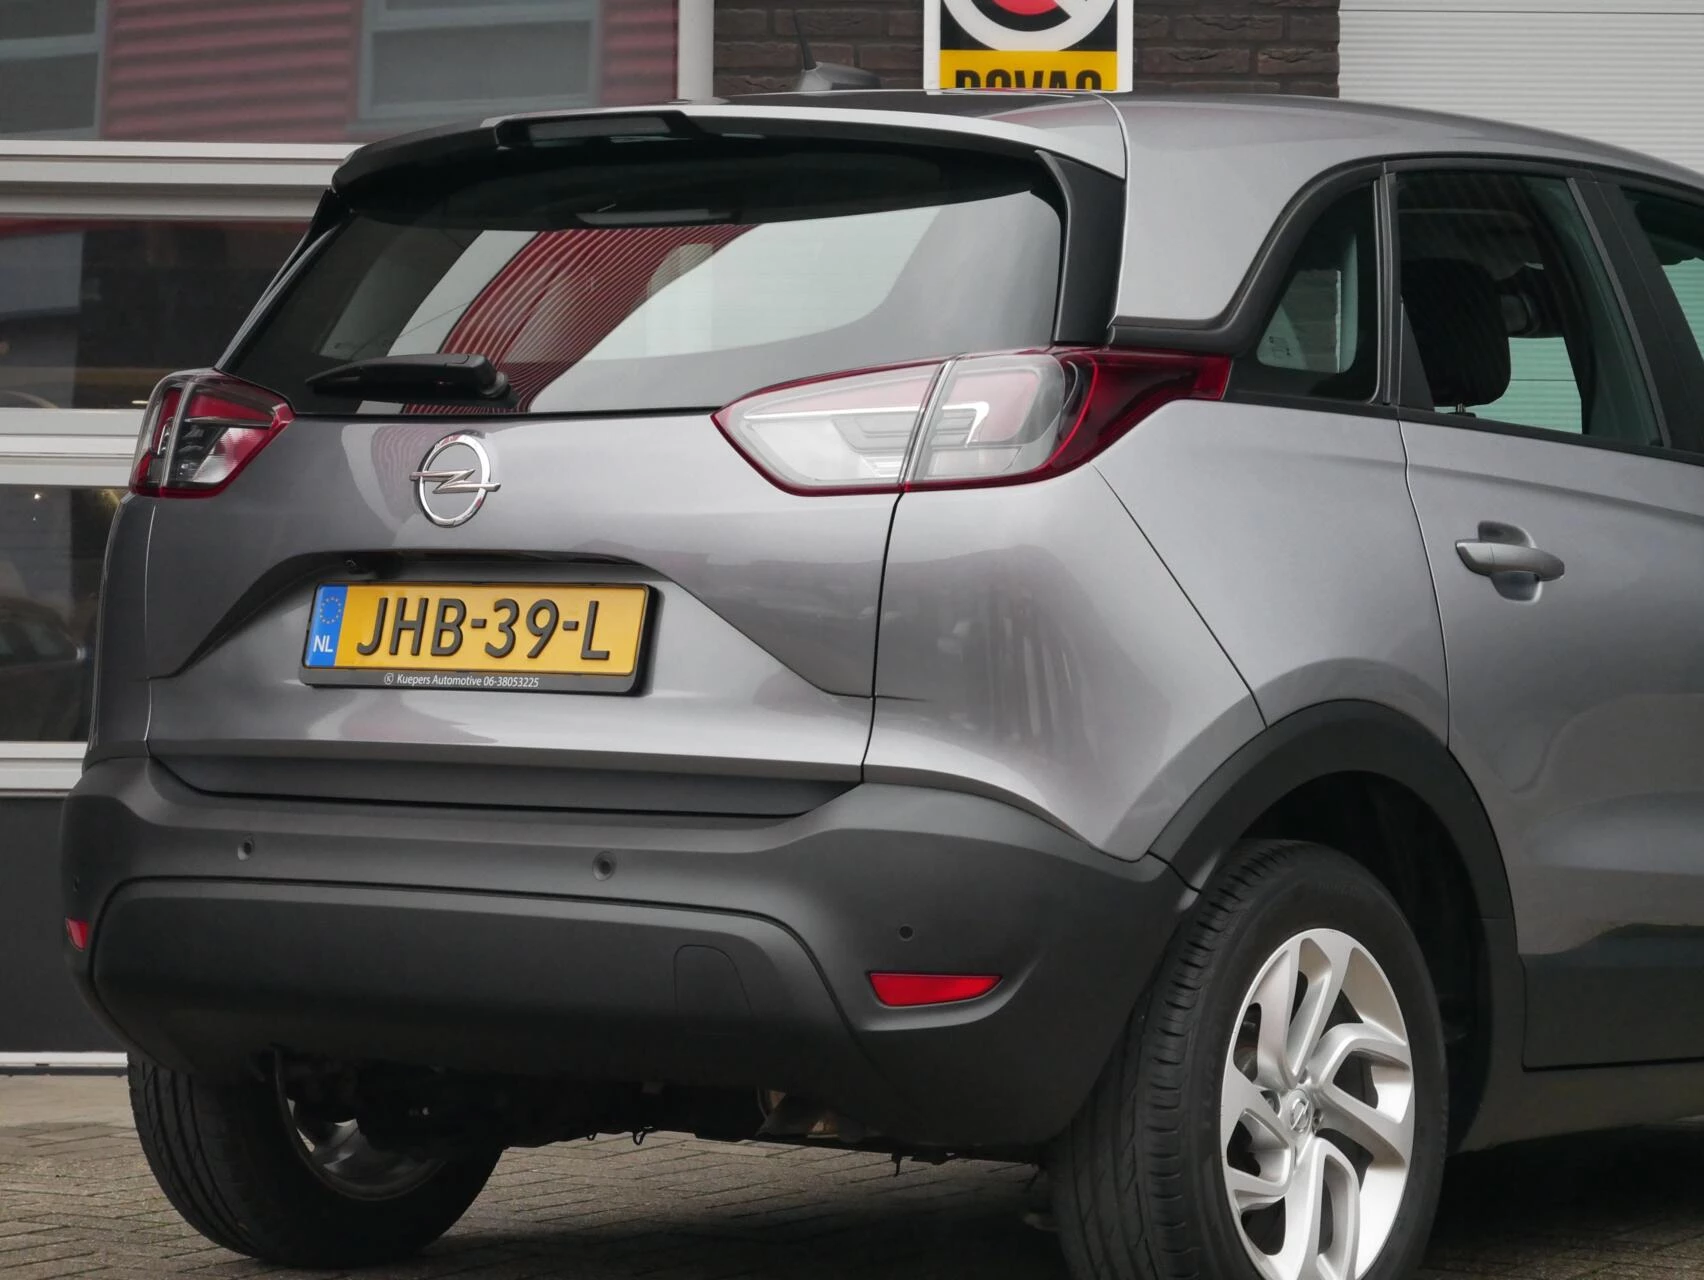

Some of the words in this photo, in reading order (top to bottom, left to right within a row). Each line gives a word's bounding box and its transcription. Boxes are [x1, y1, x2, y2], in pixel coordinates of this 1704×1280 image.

[356, 597, 611, 661] JHB-39-L
[312, 635, 334, 653] NL
[396, 673, 431, 687] Kuepers
[432, 674, 482, 687] Automotive
[483, 675, 540, 688] 06-38053225
